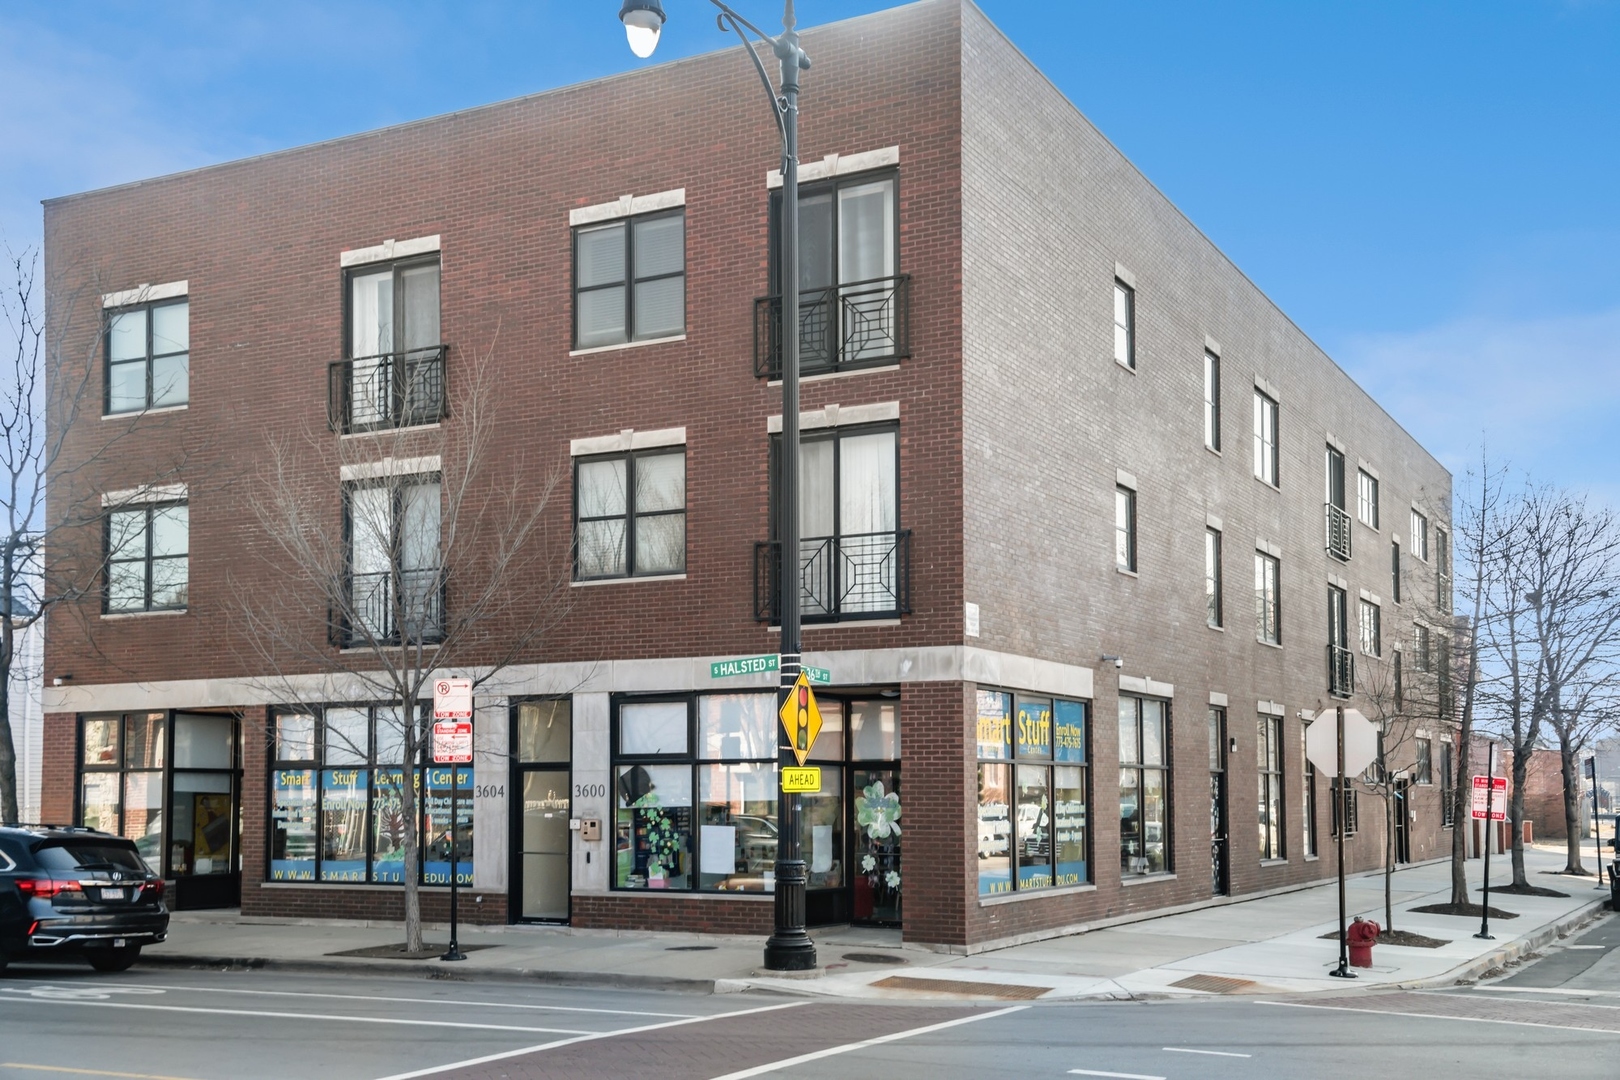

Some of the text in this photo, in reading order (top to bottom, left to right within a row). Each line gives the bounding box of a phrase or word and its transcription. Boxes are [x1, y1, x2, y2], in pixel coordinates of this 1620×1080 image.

[720, 658, 766, 676] HALSTED
[768, 659, 776, 668] ST
[822, 673, 828, 681] ST
[977, 710, 1050, 746] mart Stuff
[1056, 722, 1081, 737] Enroll Now
[281, 772, 310, 786] Smart
[332, 771, 358, 785] Stuff
[432, 771, 468, 785] Cener
[789, 773, 814, 786] AHEAD
[475, 784, 505, 799] 3604
[574, 783, 606, 798] 3600
[321, 798, 347, 810] Enroll
[347, 798, 367, 810] Now
